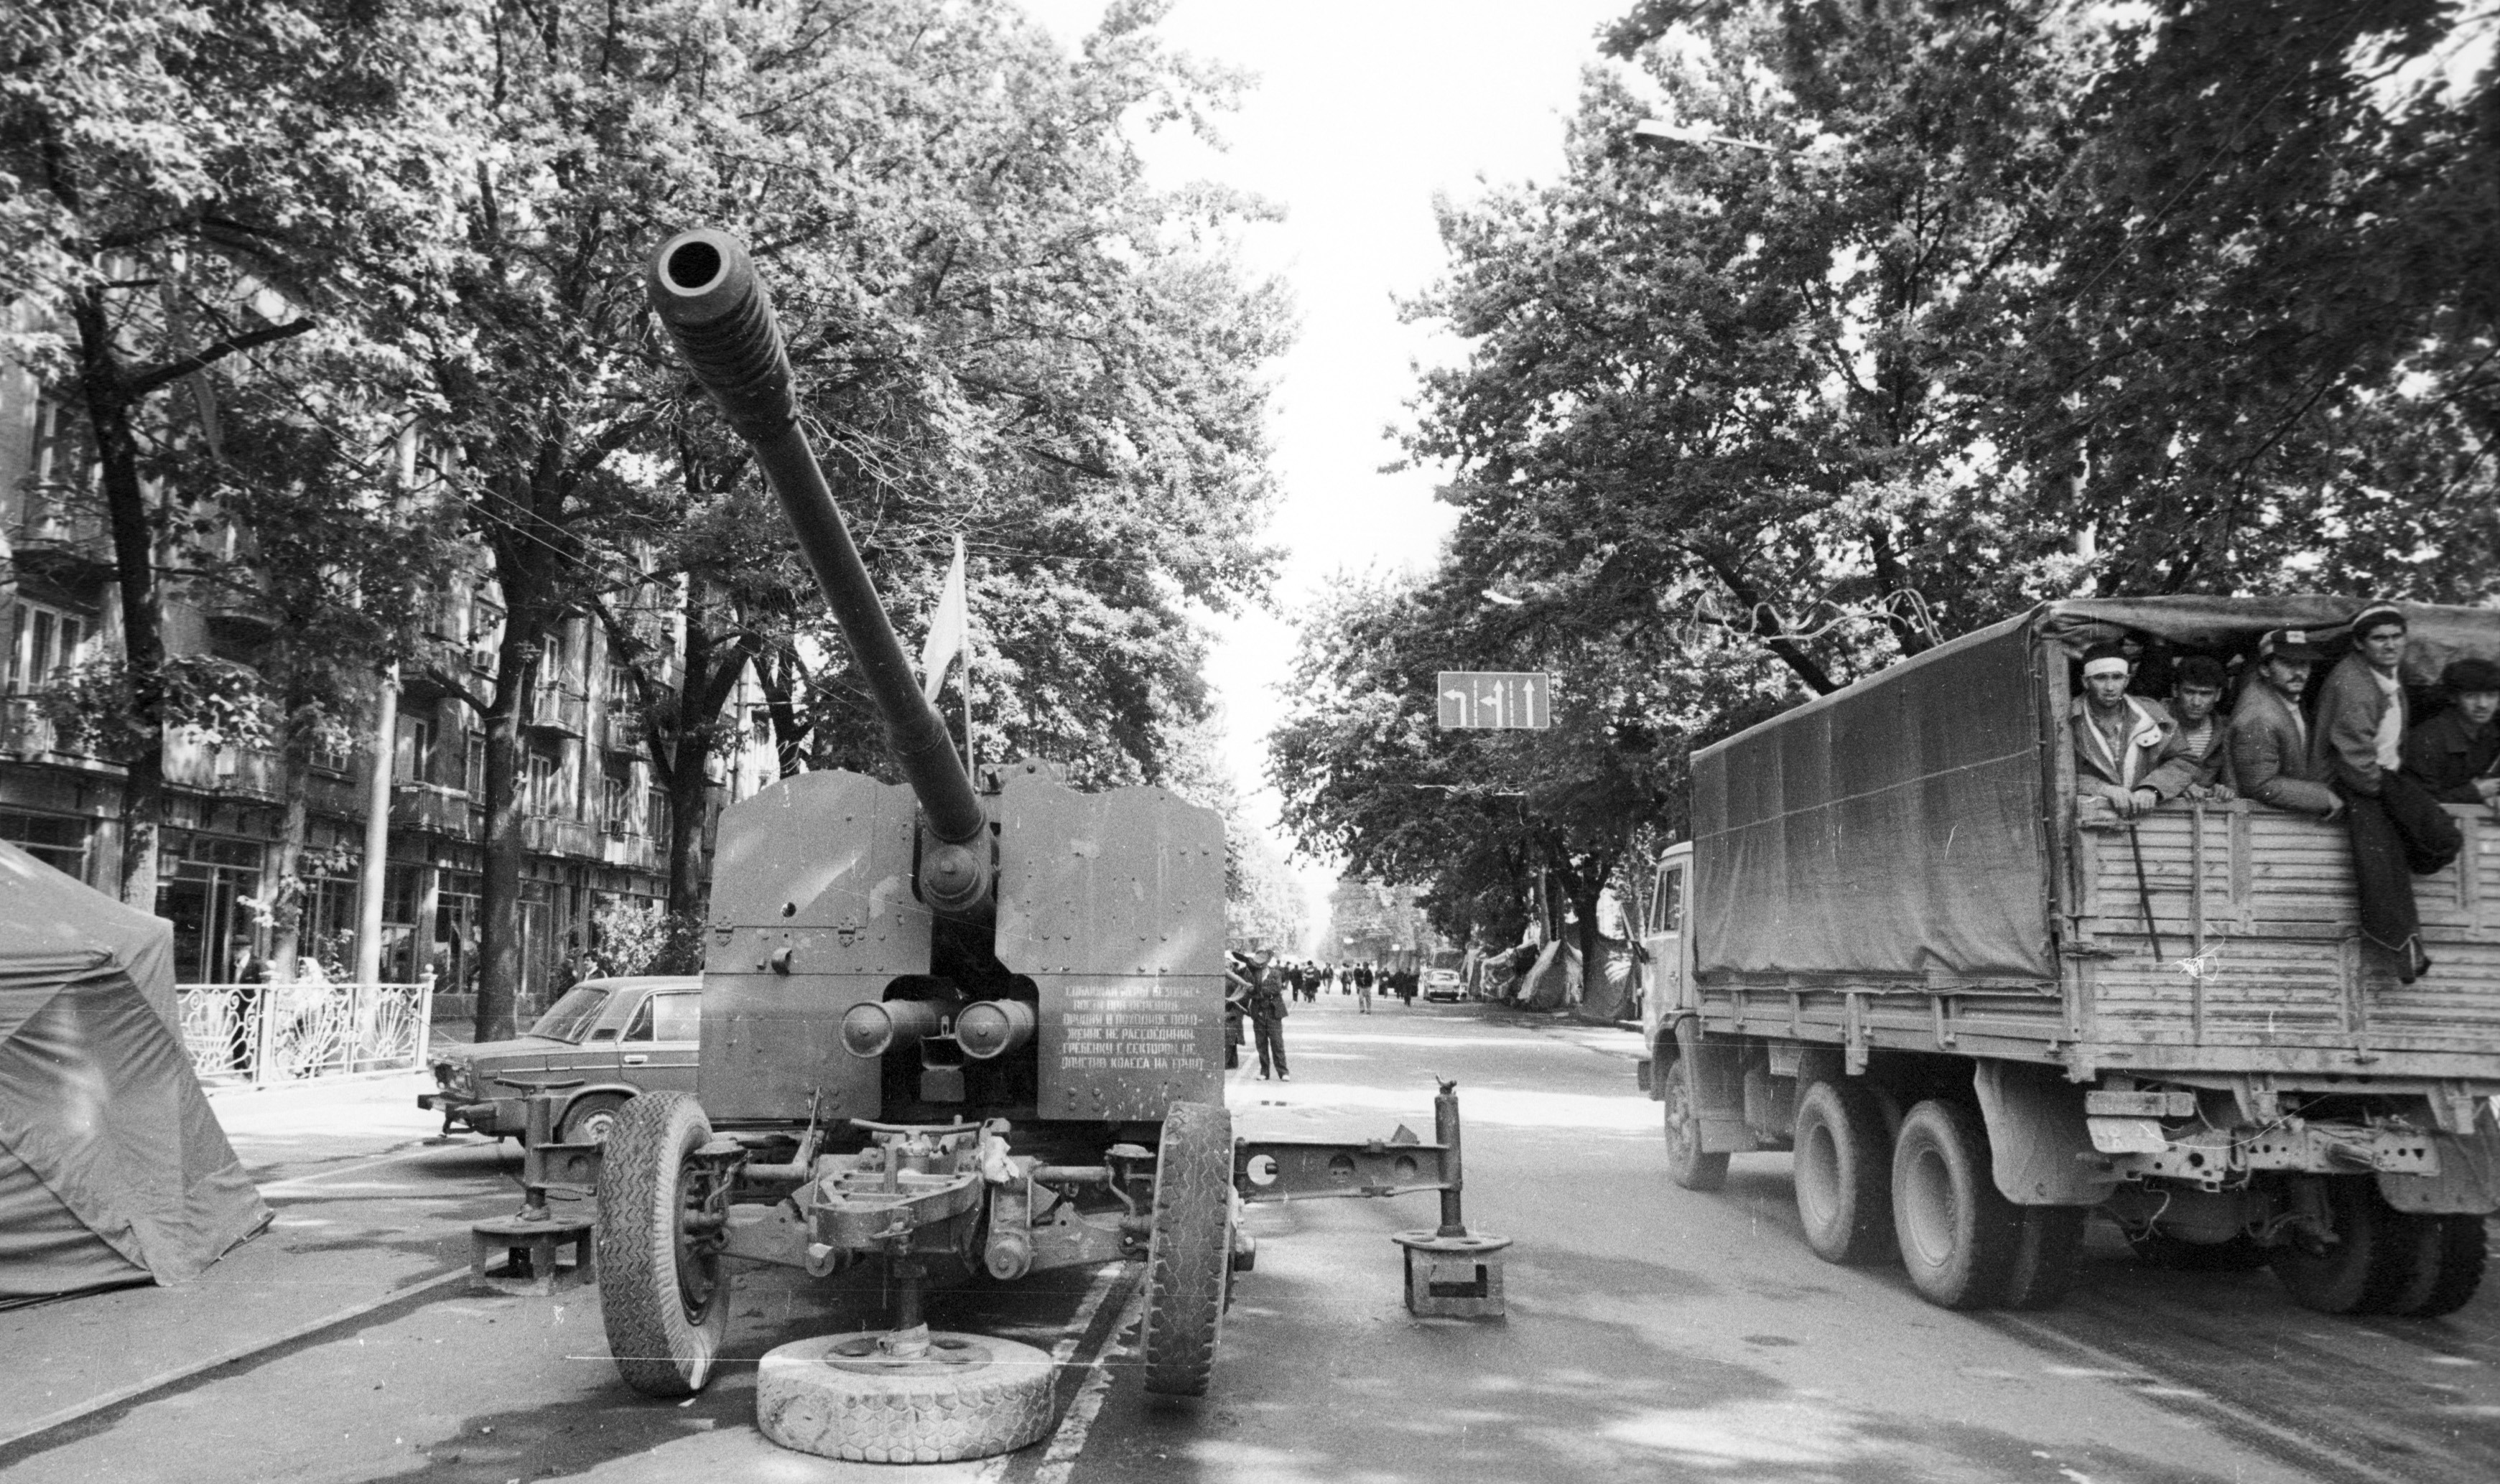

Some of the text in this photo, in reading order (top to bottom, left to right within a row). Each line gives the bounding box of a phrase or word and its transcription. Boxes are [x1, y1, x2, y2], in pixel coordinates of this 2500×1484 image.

[1067, 1027, 1102, 1040] ЖЕНИЕ
[1106, 1027, 1118, 1040] НЕ
[1063, 1042, 1112, 1053] ГРЕБЕНКУ
[1117, 1042, 1123, 1053] С
[1111, 1058, 1150, 1068] КОЛЕСА
[1154, 1058, 1168, 1069] НА
